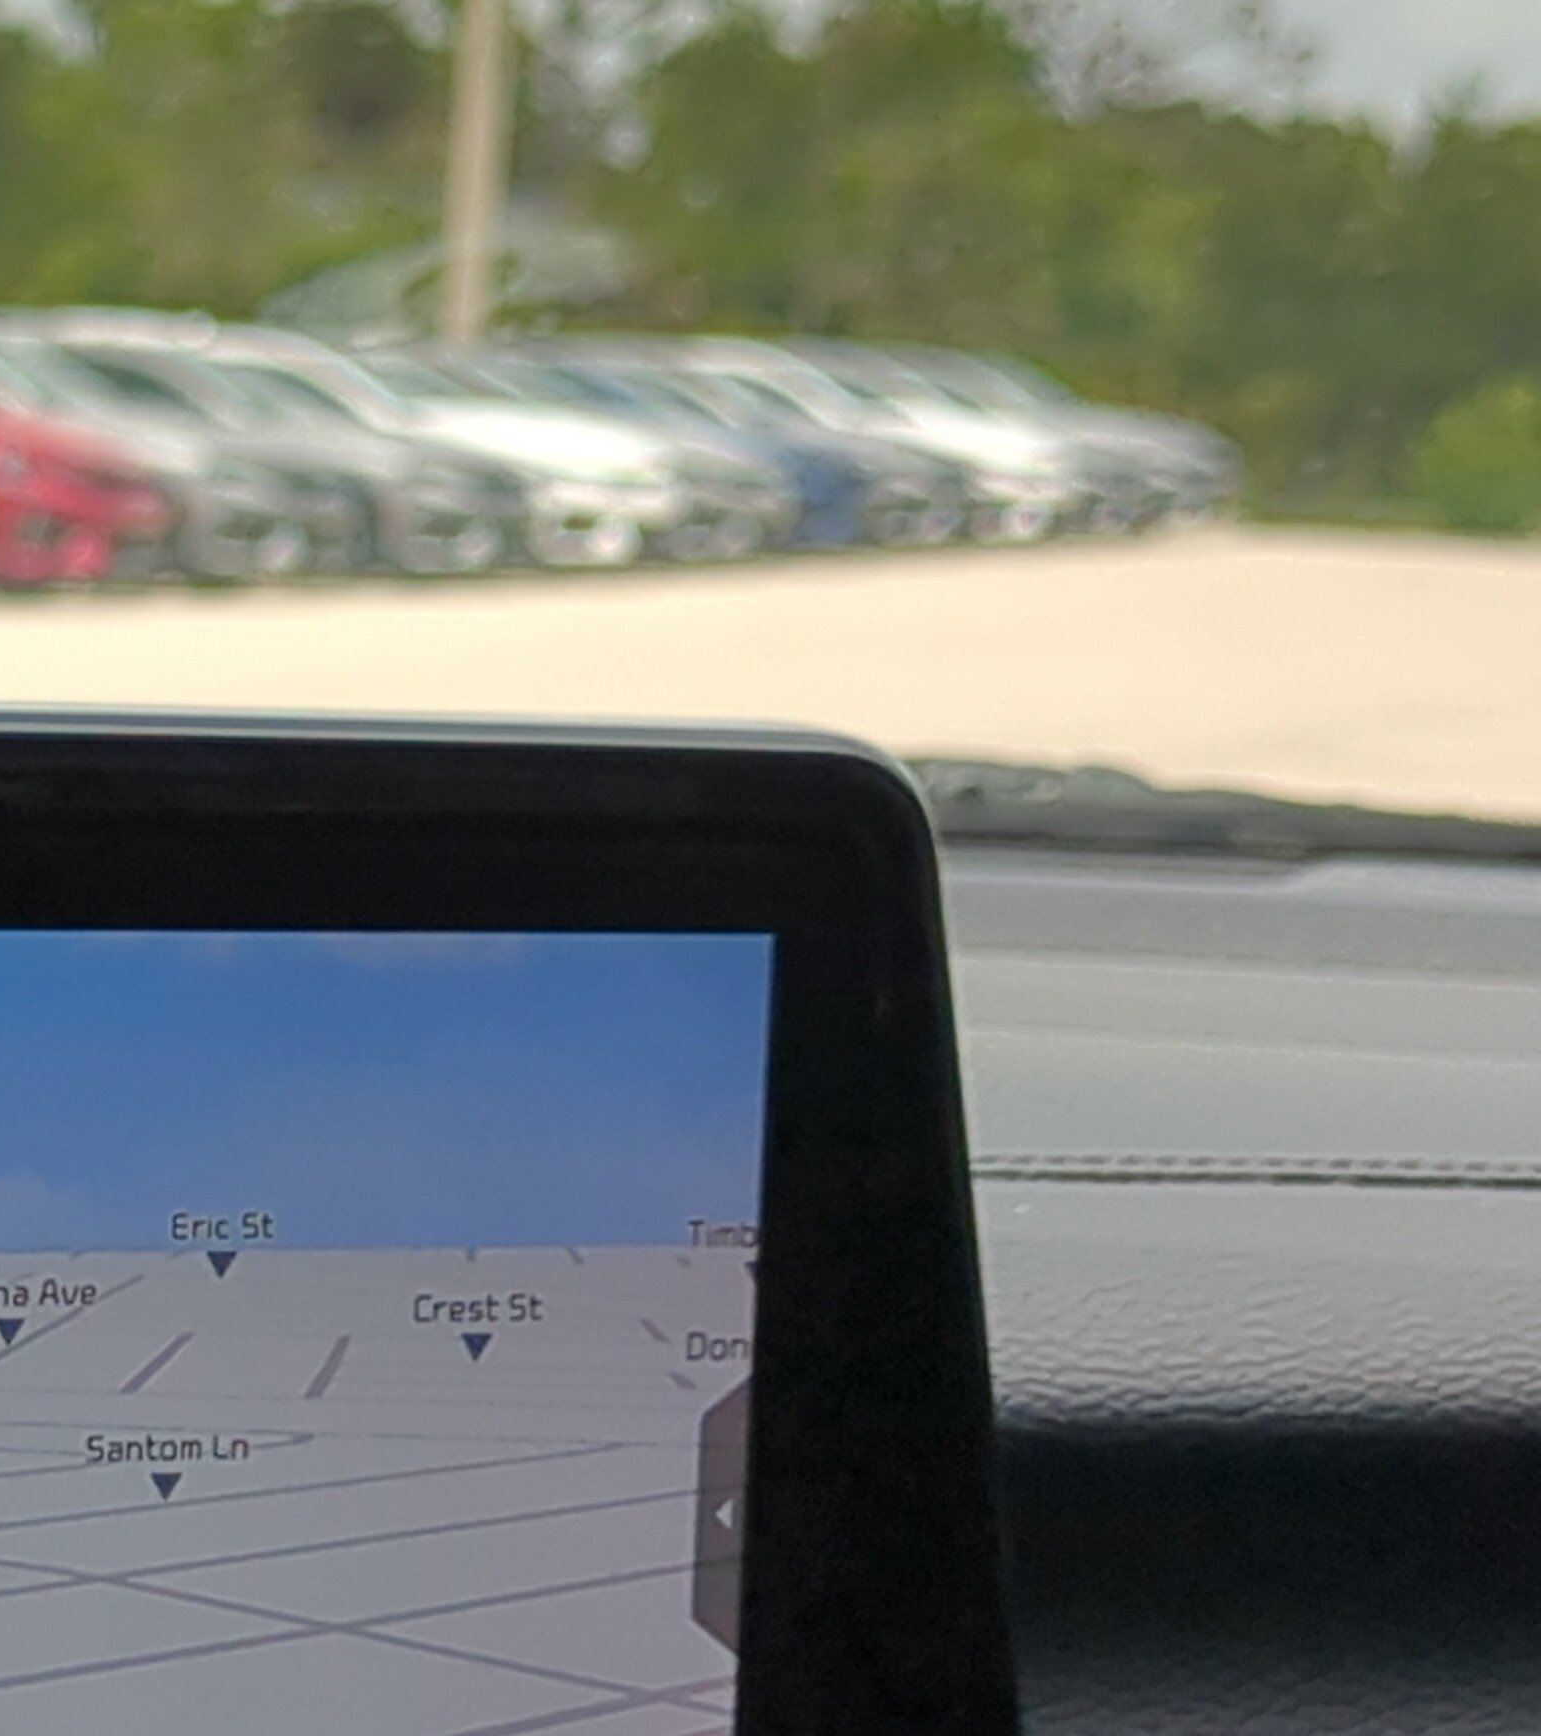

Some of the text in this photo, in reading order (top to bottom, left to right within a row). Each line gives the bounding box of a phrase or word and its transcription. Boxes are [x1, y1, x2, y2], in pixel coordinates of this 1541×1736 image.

[171, 1213, 274, 1241] Eric St
[39, 1281, 97, 1307] Ave
[414, 1294, 543, 1323] Crest St
[86, 1435, 248, 1463] Santom Ln
